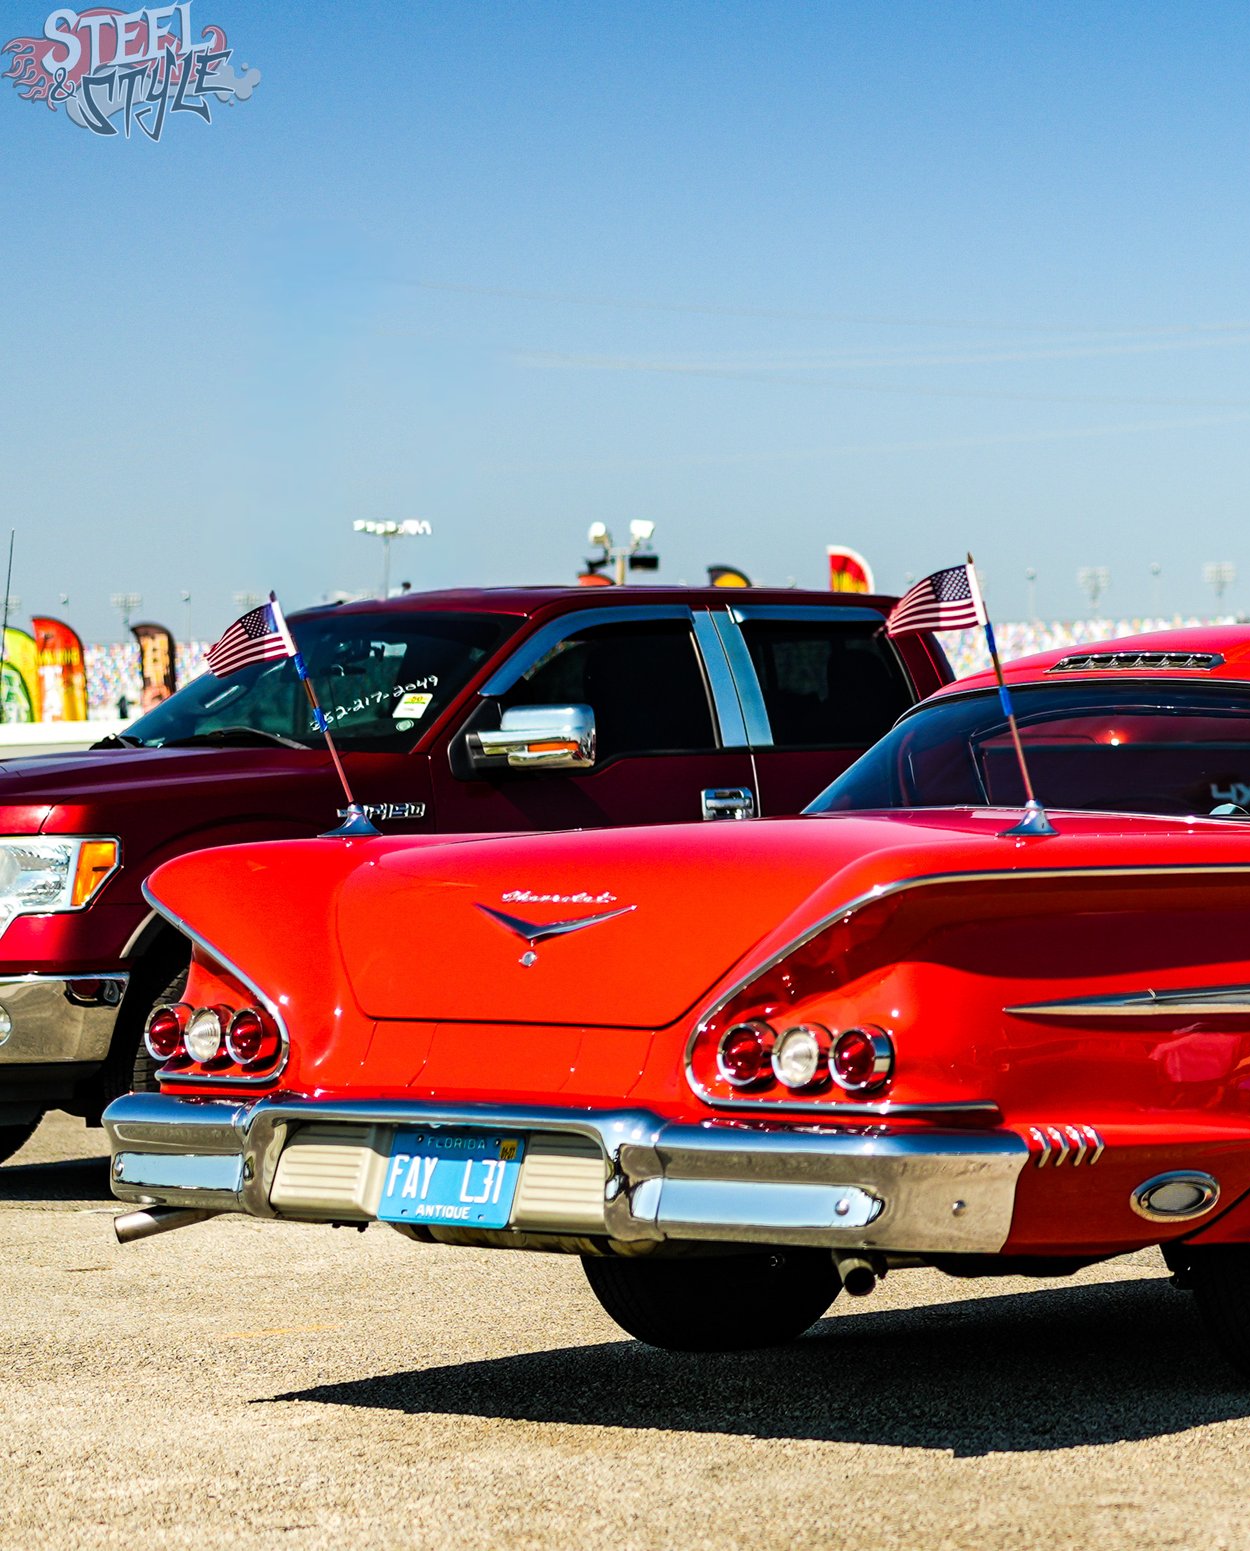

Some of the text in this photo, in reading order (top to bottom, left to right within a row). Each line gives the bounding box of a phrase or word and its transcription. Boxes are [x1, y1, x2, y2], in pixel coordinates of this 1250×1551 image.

[427, 1136, 486, 1150] FLORIDA
[386, 1153, 439, 1200] FAY
[415, 1204, 473, 1220] ANTIQUE
